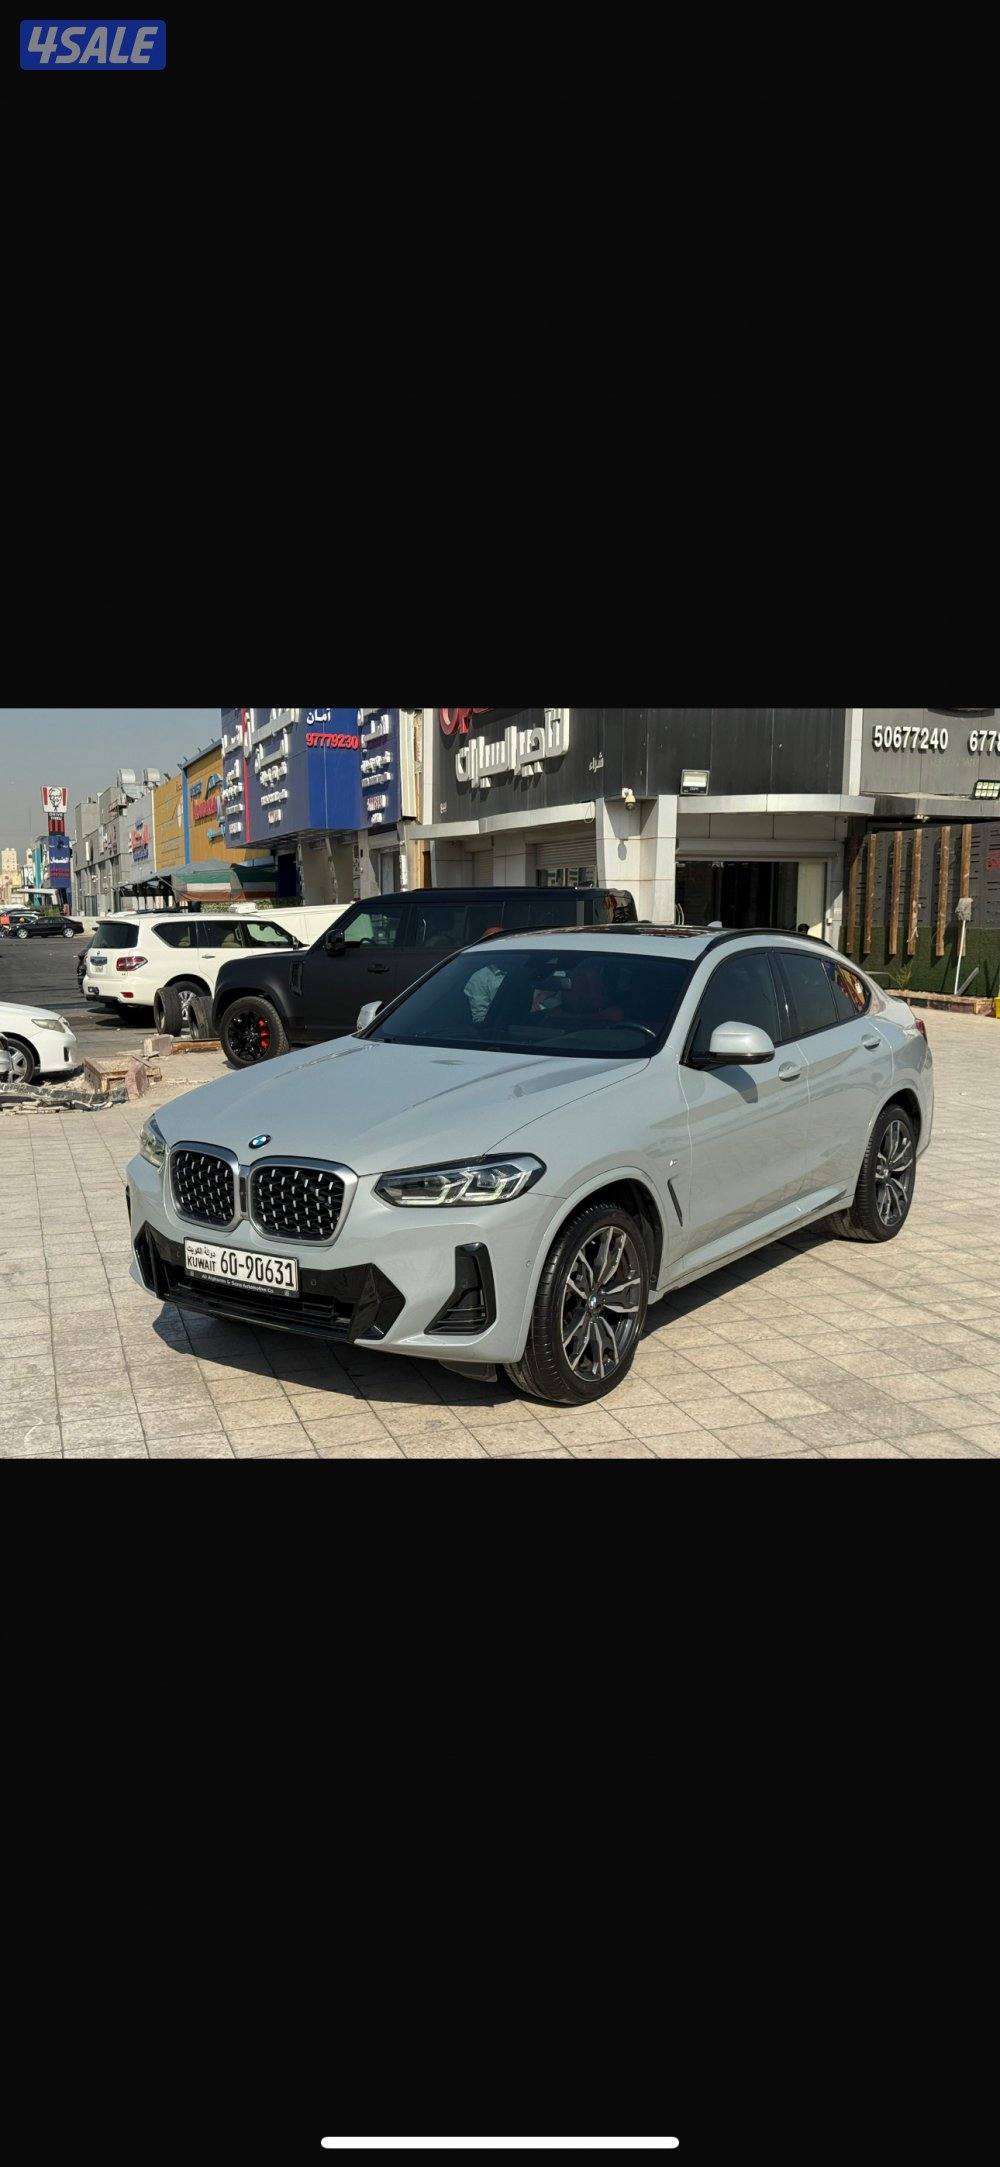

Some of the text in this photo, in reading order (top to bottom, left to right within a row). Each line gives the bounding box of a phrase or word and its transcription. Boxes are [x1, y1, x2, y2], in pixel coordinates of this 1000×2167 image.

[306, 732, 360, 750] 97779230
[874, 725, 949, 750] 50677240
[187, 1256, 216, 1272] KUWAIT
[220, 1250, 295, 1288] 60-90631
